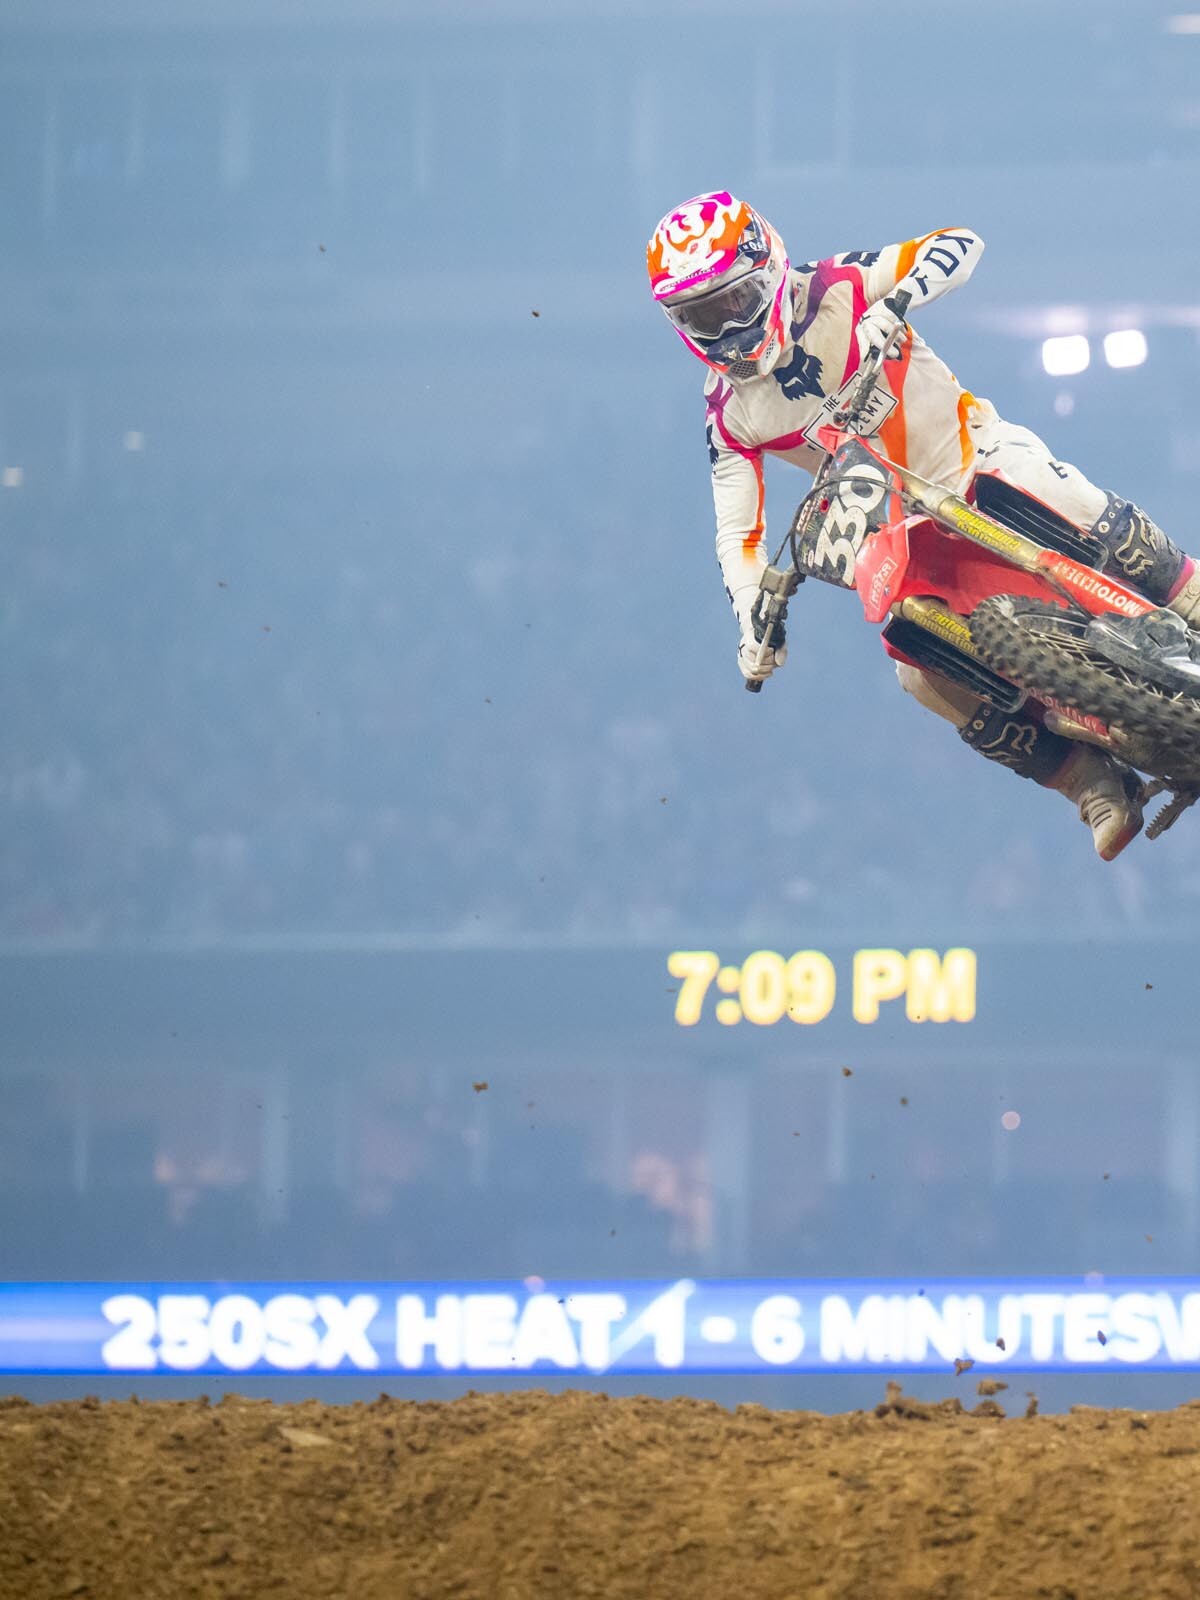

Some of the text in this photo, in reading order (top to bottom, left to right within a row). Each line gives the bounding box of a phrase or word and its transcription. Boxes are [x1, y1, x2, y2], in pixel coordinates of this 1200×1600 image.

[821, 395, 841, 413] THE
[813, 463, 887, 588] 330
[666, 947, 977, 1026] 7:09 PM
[101, 1293, 380, 1370] 250SX
[395, 1293, 626, 1369] HEAT
[750, 1294, 805, 1365] 6
[819, 1292, 1162, 1364] MINUTES
